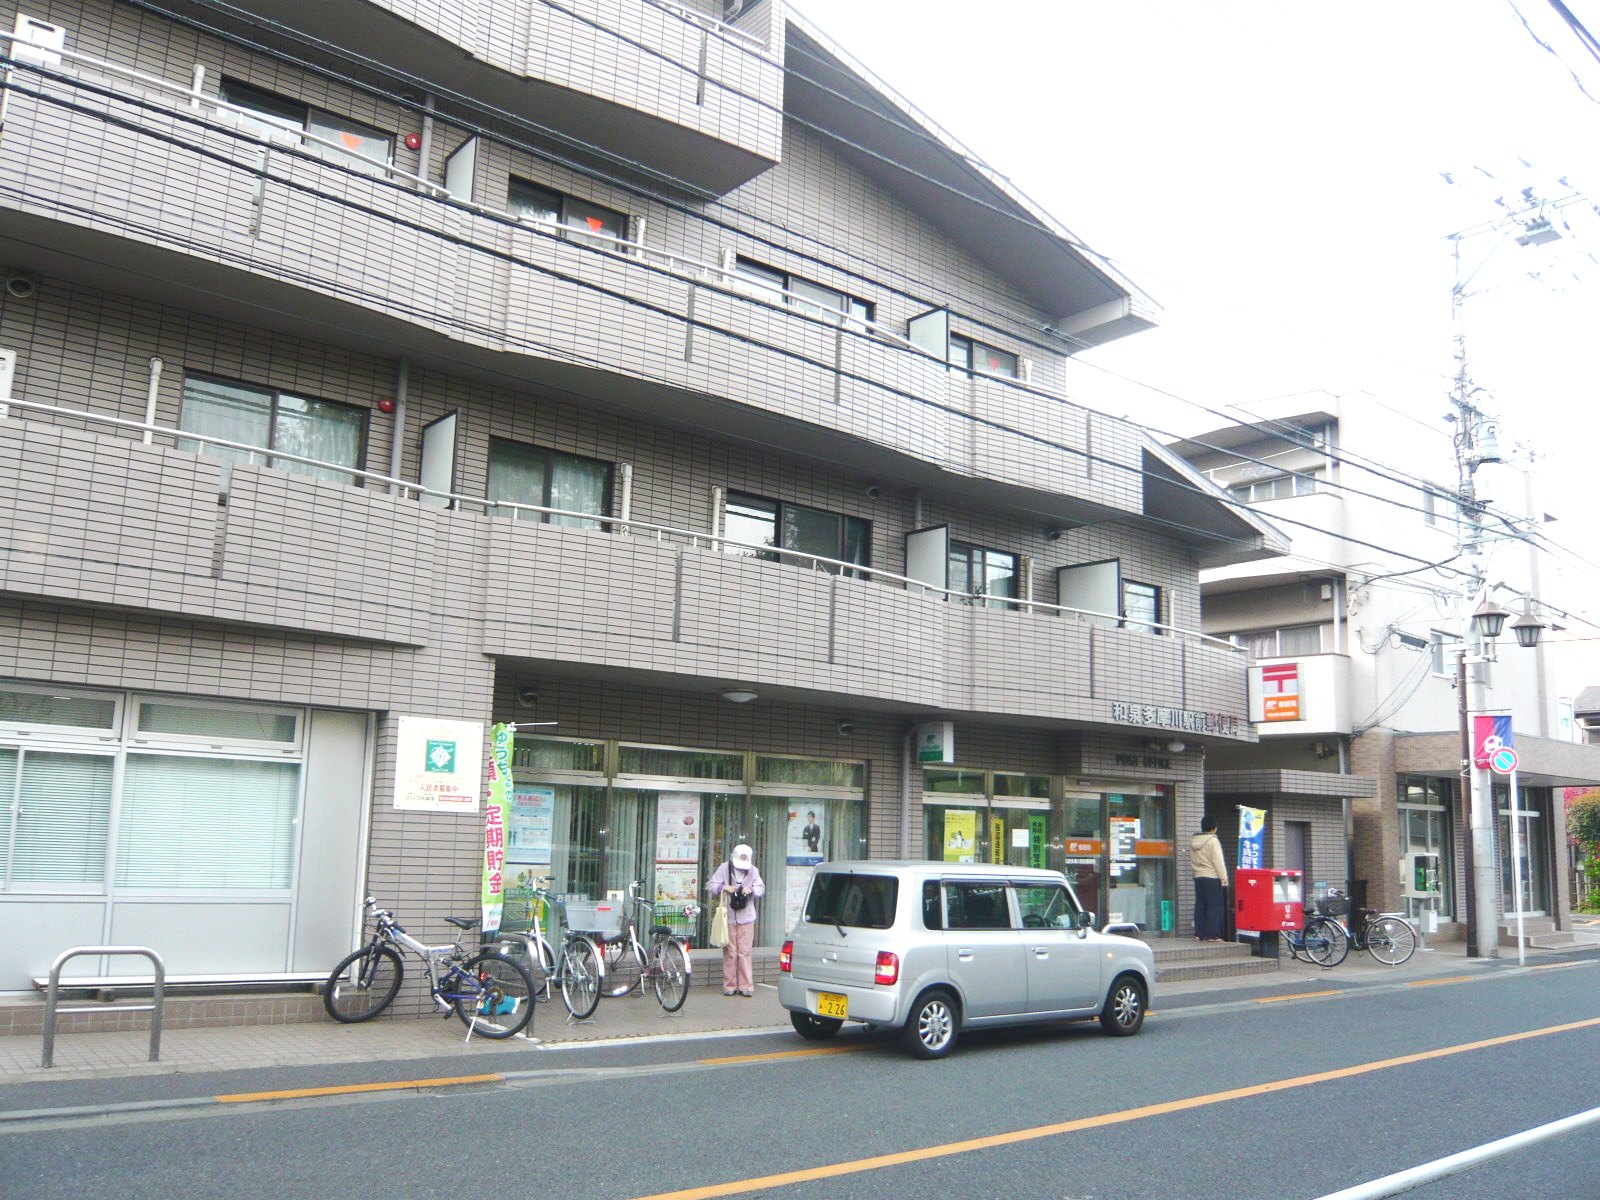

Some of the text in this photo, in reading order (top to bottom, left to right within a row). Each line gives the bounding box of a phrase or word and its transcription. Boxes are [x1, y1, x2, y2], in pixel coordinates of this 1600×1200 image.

[1112, 701, 1239, 736] 和泉多摩川駅前郵便局
[495, 730, 513, 801] ゆうちょの
[1116, 753, 1169, 770] POST OFFICE
[419, 783, 459, 794] 入居者募集中
